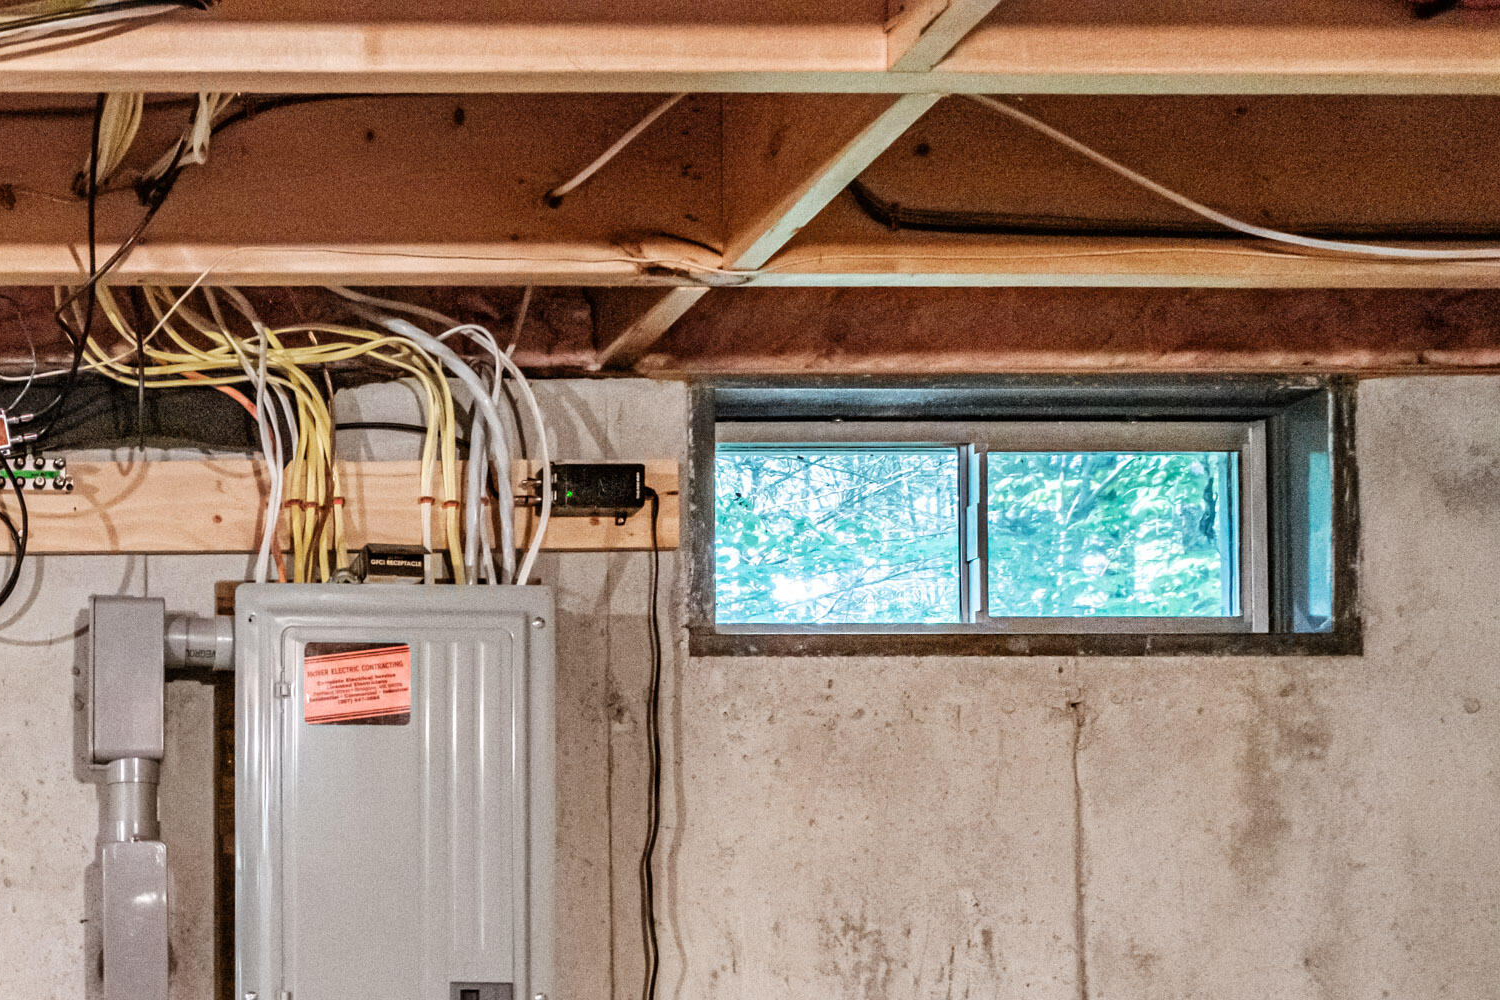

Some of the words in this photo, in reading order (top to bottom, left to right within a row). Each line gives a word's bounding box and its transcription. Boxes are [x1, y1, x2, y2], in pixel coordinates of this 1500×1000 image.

[370, 558, 386, 566] GFCI
[386, 559, 422, 567] RECEPTACLE
[331, 665, 359, 675] ELECTRIC
[361, 660, 404, 672] CONTRACTING
